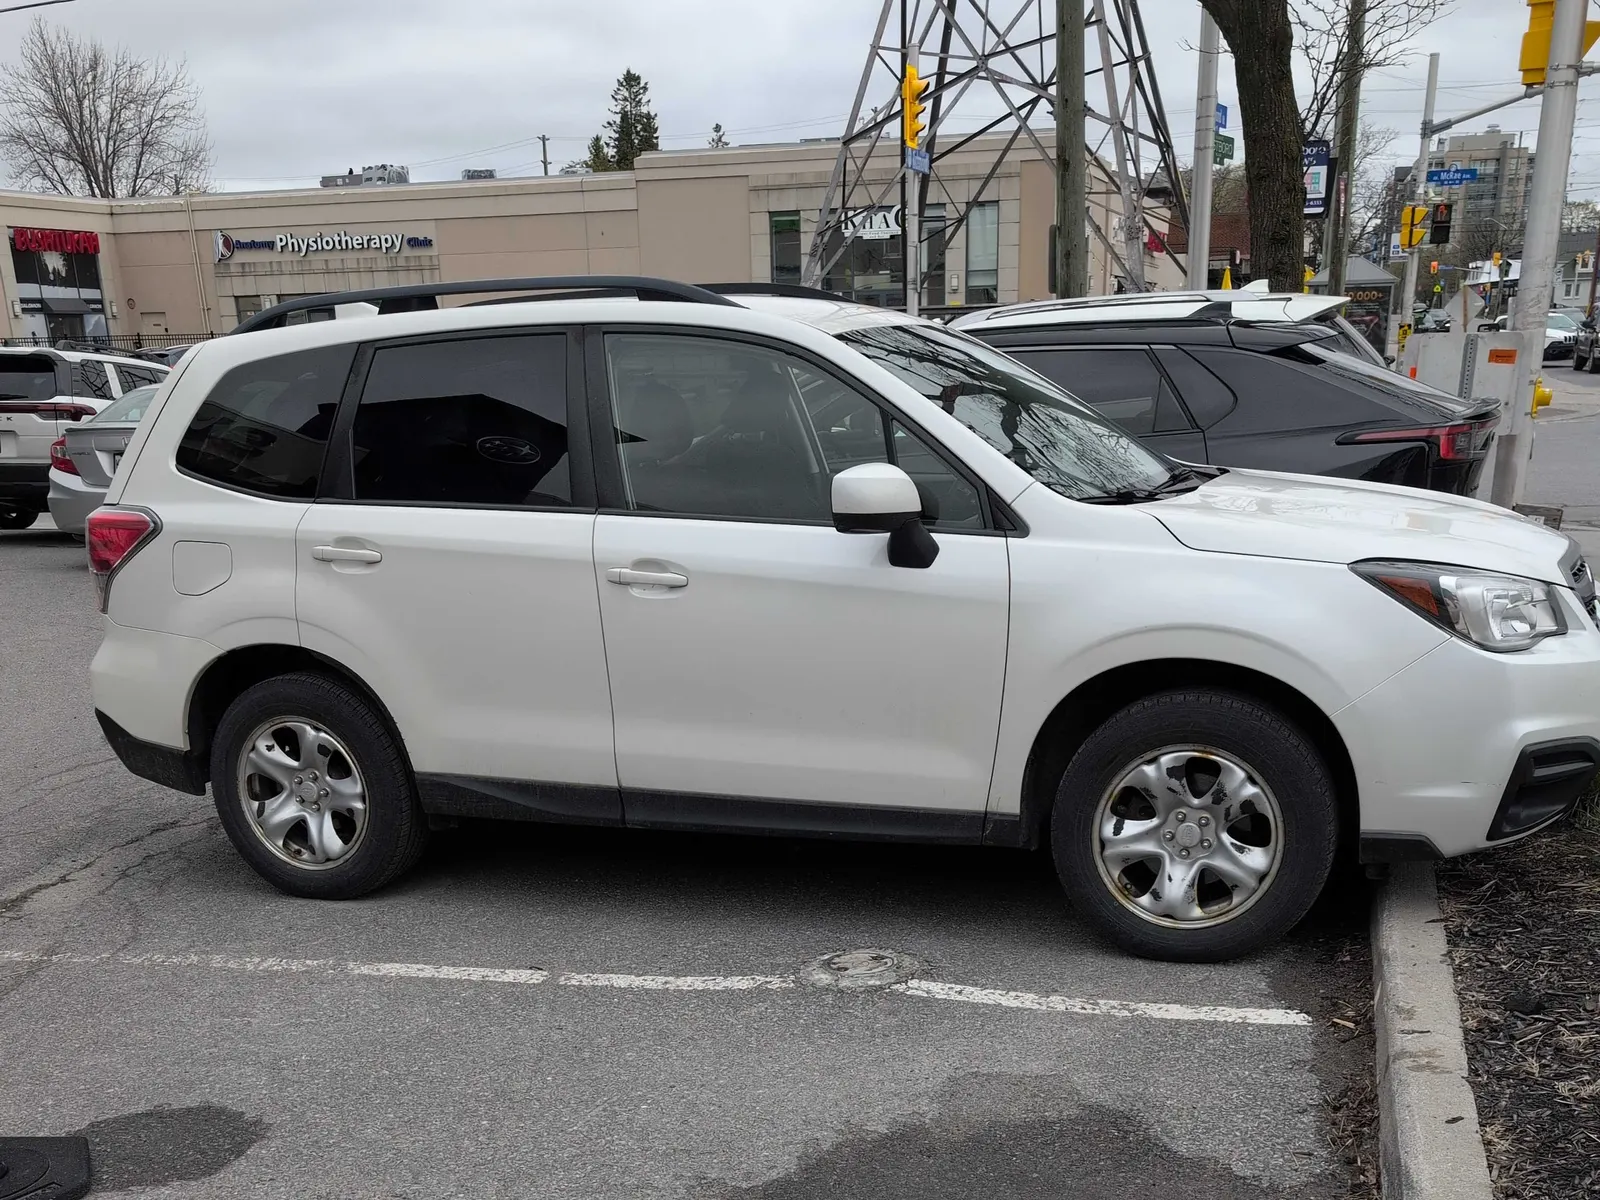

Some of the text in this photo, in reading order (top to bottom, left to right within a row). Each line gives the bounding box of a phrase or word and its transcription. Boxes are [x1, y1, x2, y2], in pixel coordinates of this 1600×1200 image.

[1440, 171, 1462, 180] McRae
[13, 228, 100, 255] BUSHTUKAH
[275, 231, 403, 257] Physiotherapy
[406, 236, 433, 248] Clinic
[1344, 291, 1384, 302] 0,000+
